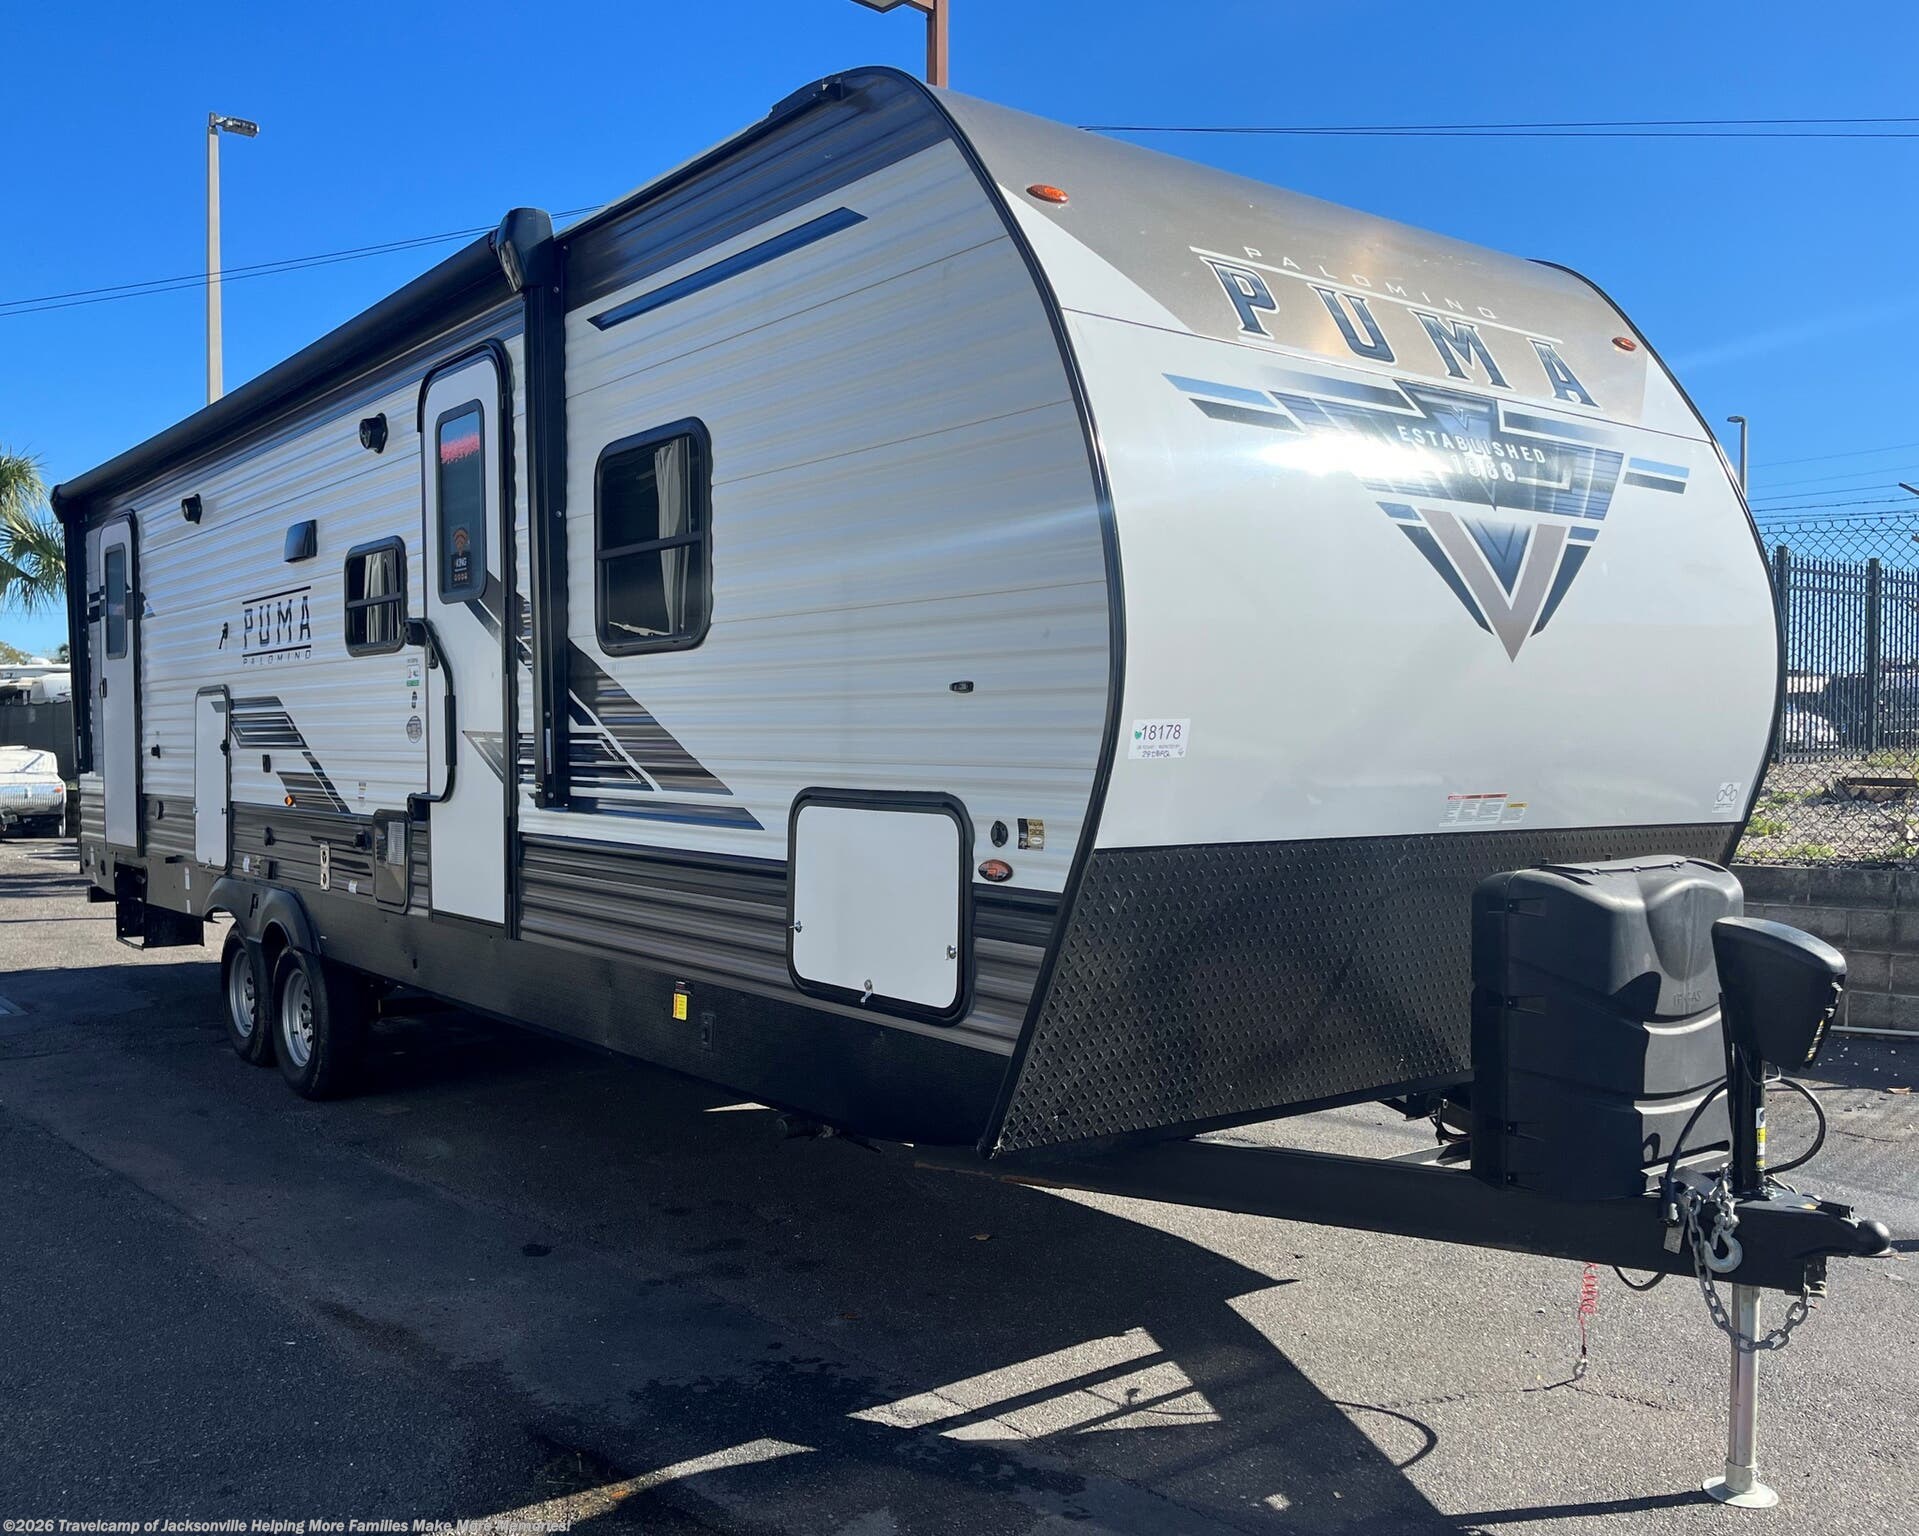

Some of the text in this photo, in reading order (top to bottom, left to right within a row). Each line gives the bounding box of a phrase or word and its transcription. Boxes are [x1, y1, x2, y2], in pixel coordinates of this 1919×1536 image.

[1243, 246, 1496, 319] PALOMINO
[1200, 257, 1600, 406] PUMA
[1397, 425, 1546, 464] ESTABLISHED
[243, 595, 311, 650] PUMA
[243, 649, 311, 665] PALOMINO
[1142, 724, 1181, 740] 18178
